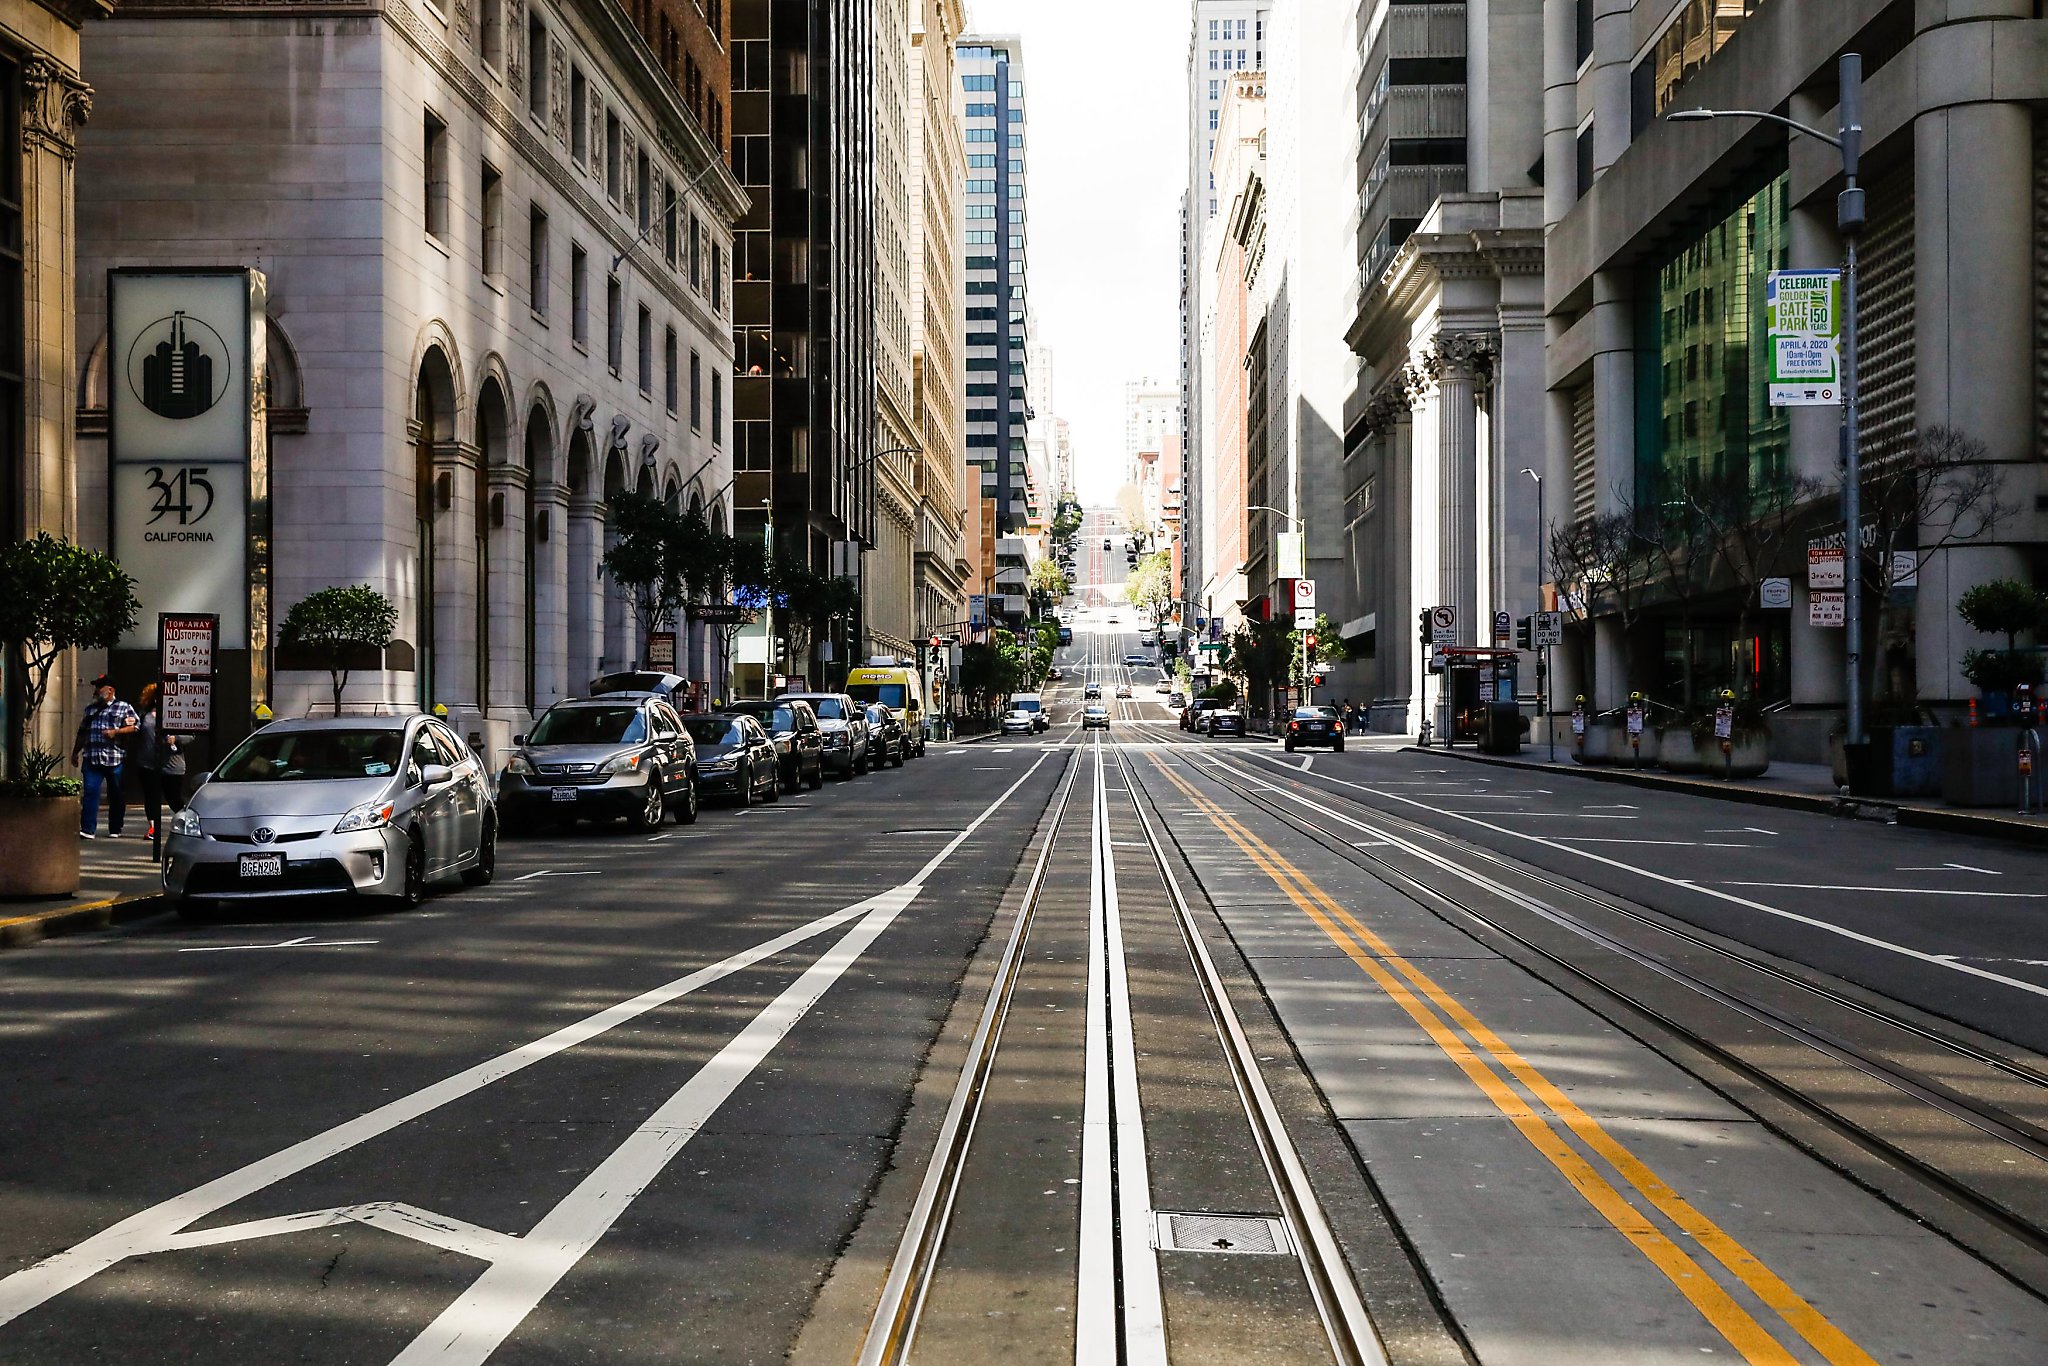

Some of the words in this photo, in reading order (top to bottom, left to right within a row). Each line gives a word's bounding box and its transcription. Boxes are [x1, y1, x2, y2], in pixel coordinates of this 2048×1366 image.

[1780, 277, 1828, 289] CELEBRATE
[1780, 291, 1809, 301] GOLDEN
[1780, 301, 1809, 317] GATE
[1810, 308, 1828, 323] 150
[1780, 317, 1808, 331] PARK
[1810, 323, 1828, 331] YEARS
[1780, 341, 1801, 350] APRIL
[1810, 340, 1828, 349] 2020
[1786, 350, 1822, 359] 10am-10pm
[1801, 359, 1822, 367] EVENTS
[145, 467, 214, 525] 345
[144, 532, 214, 542] CALIFORNIA
[1809, 556, 1819, 564] NO
[1810, 593, 1820, 603] NO
[1821, 595, 1843, 603] PARKING
[168, 620, 210, 628] TOW-AWAY
[166, 628, 179, 640] NO
[180, 631, 211, 640] STOPPING
[164, 681, 177, 695] NO
[179, 684, 209, 696] PARKING
[167, 710, 181, 719] TUES
[186, 710, 205, 719] THURS
[241, 861, 279, 873] 8GEN904
